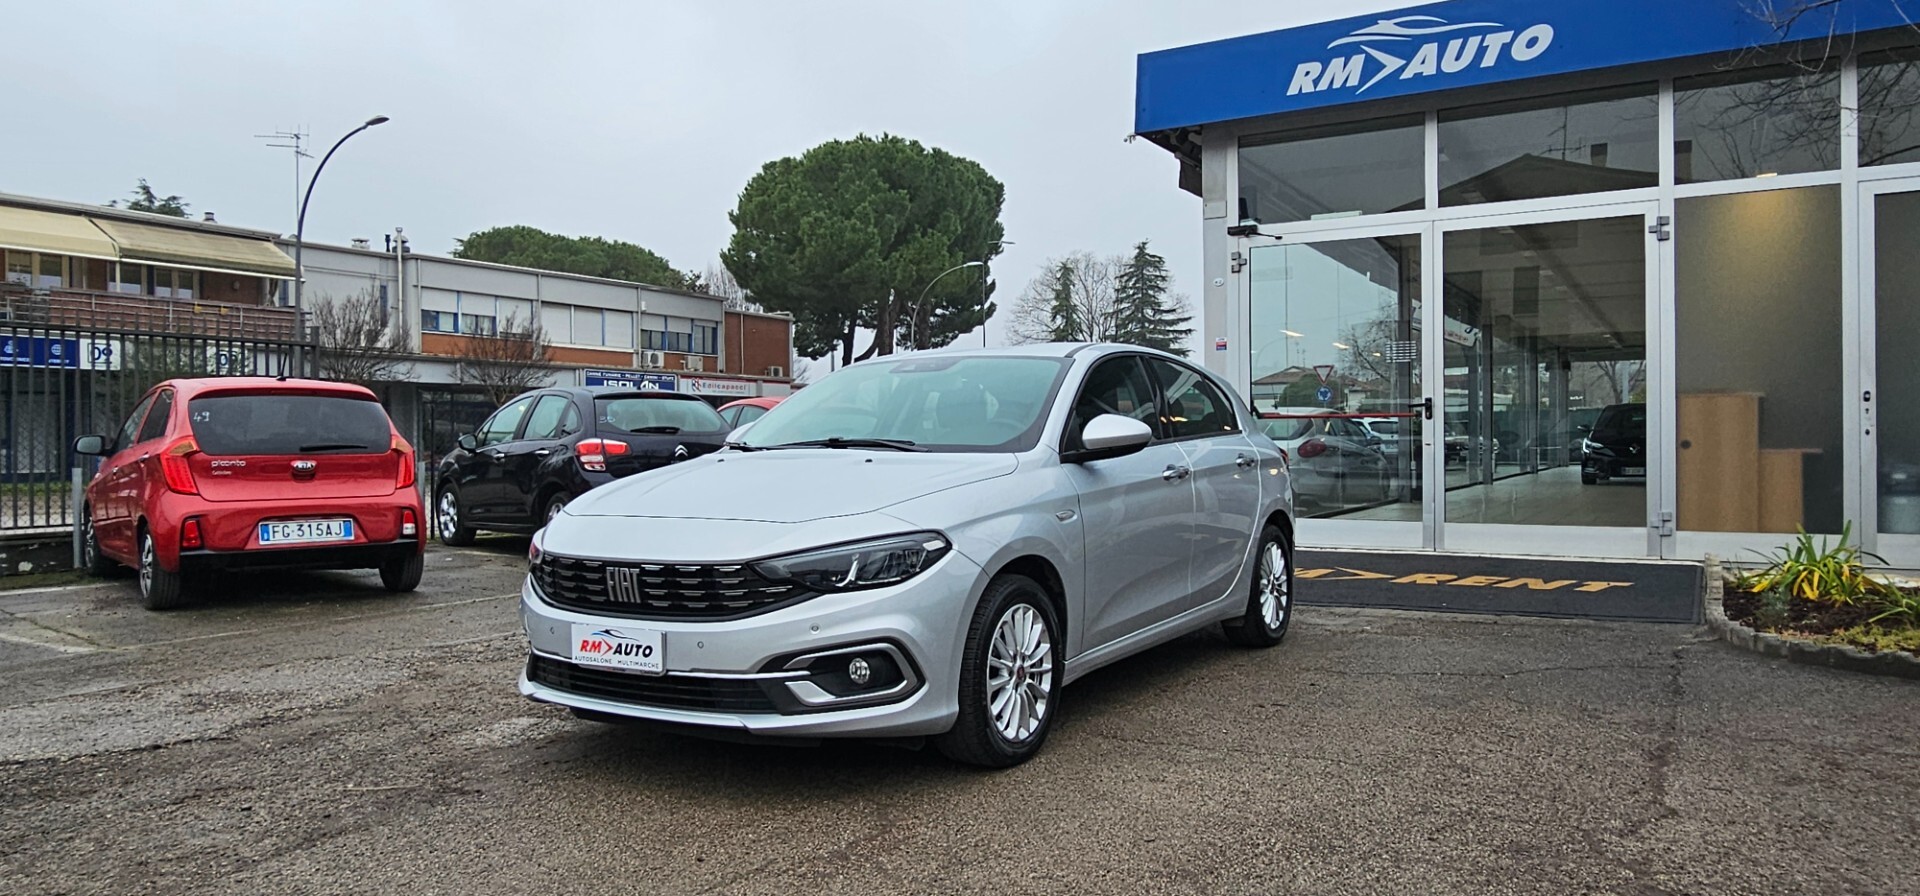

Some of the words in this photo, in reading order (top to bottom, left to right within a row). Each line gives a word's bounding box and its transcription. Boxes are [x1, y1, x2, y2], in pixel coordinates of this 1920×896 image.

[1399, 23, 1554, 80] AUTO
[193, 411, 210, 422] 49
[210, 459, 246, 468] picanto
[606, 566, 641, 603] FIAT
[1390, 573, 1635, 592] RENT
[613, 643, 653, 658] AUTO
[574, 656, 612, 664] AUTOSALONE
[617, 660, 660, 670] MULTIMARCHE
